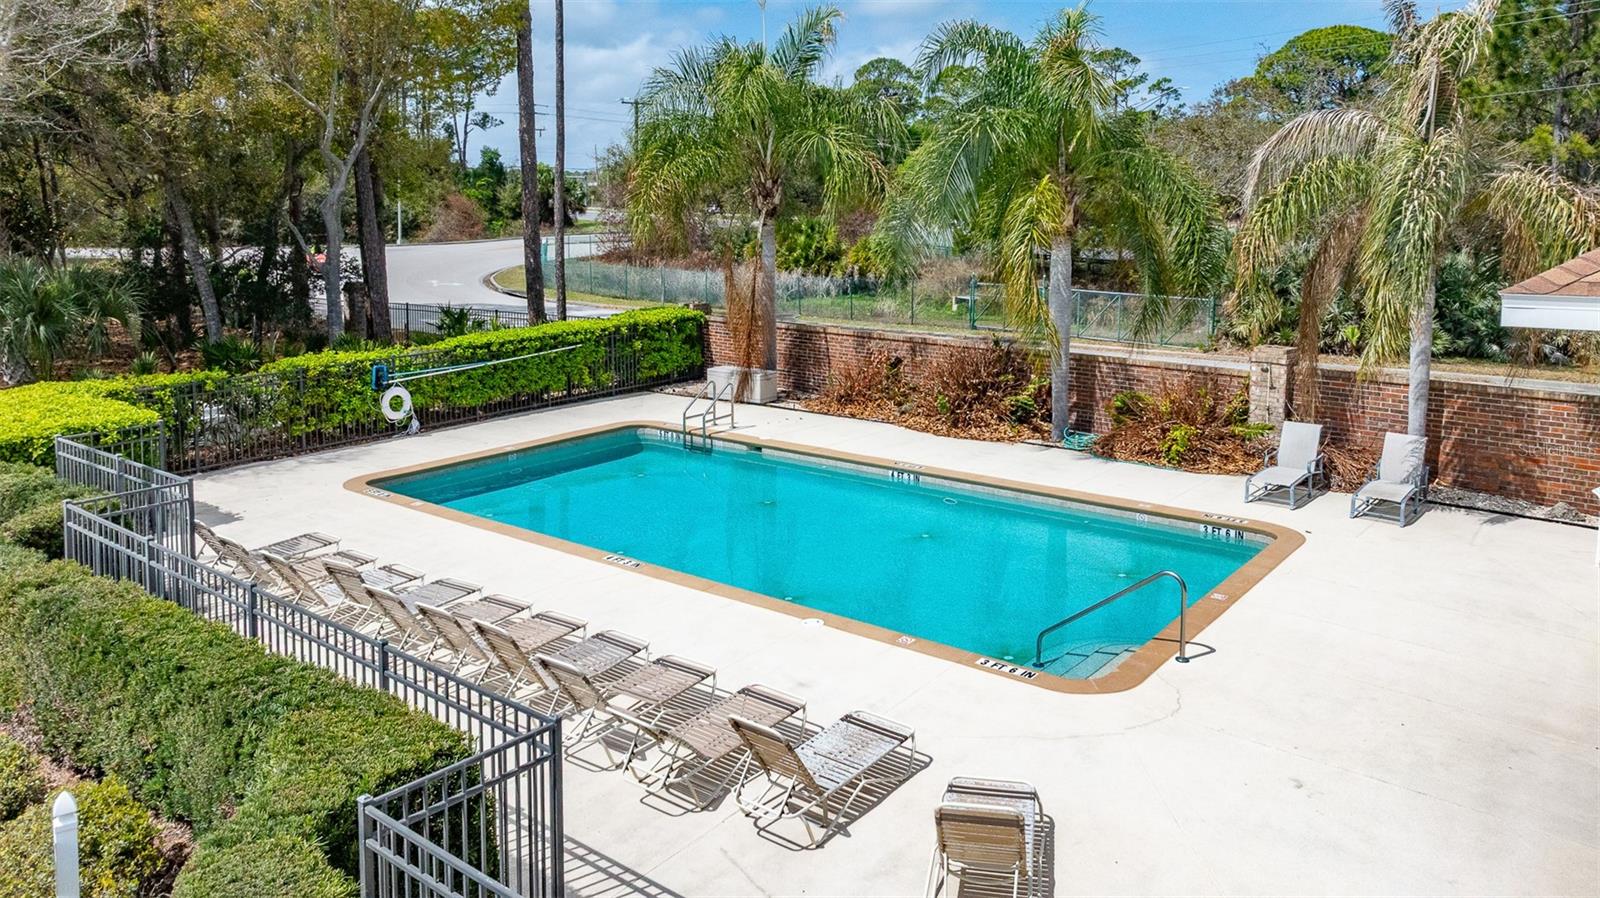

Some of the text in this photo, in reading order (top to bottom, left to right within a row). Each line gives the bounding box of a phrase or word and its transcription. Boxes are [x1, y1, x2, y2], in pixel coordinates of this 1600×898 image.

[897, 471, 905, 479] FT
[1203, 525, 1244, 539] 3 FT 6 IN
[990, 662, 1007, 670] FT
[1020, 670, 1036, 679] IN
